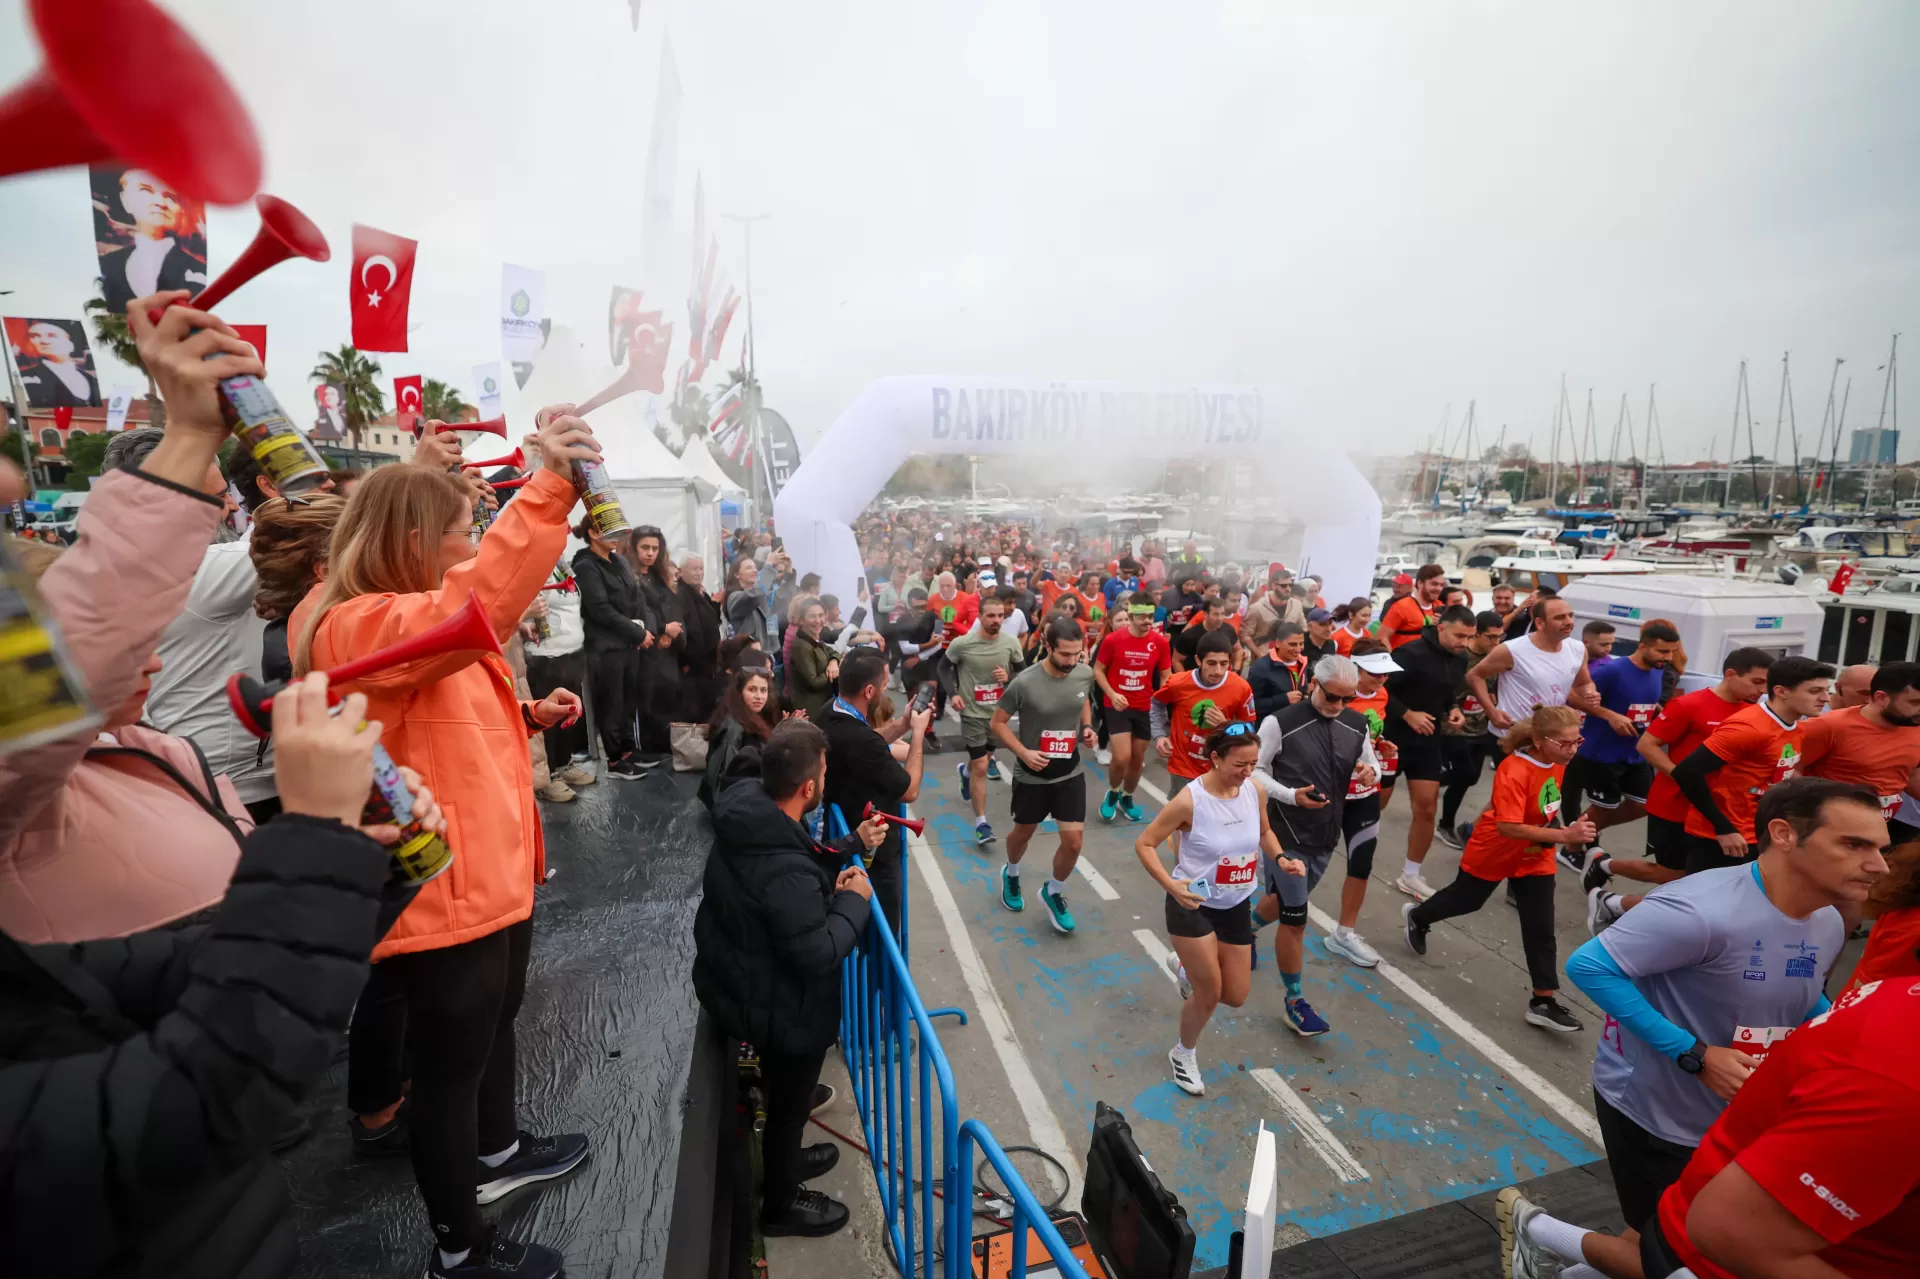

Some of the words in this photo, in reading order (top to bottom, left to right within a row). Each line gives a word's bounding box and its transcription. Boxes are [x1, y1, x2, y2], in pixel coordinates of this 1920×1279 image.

[932, 382, 1088, 441] BAKIRKÖY
[1050, 742, 1068, 752] 5123
[1230, 868, 1252, 882] 5446
